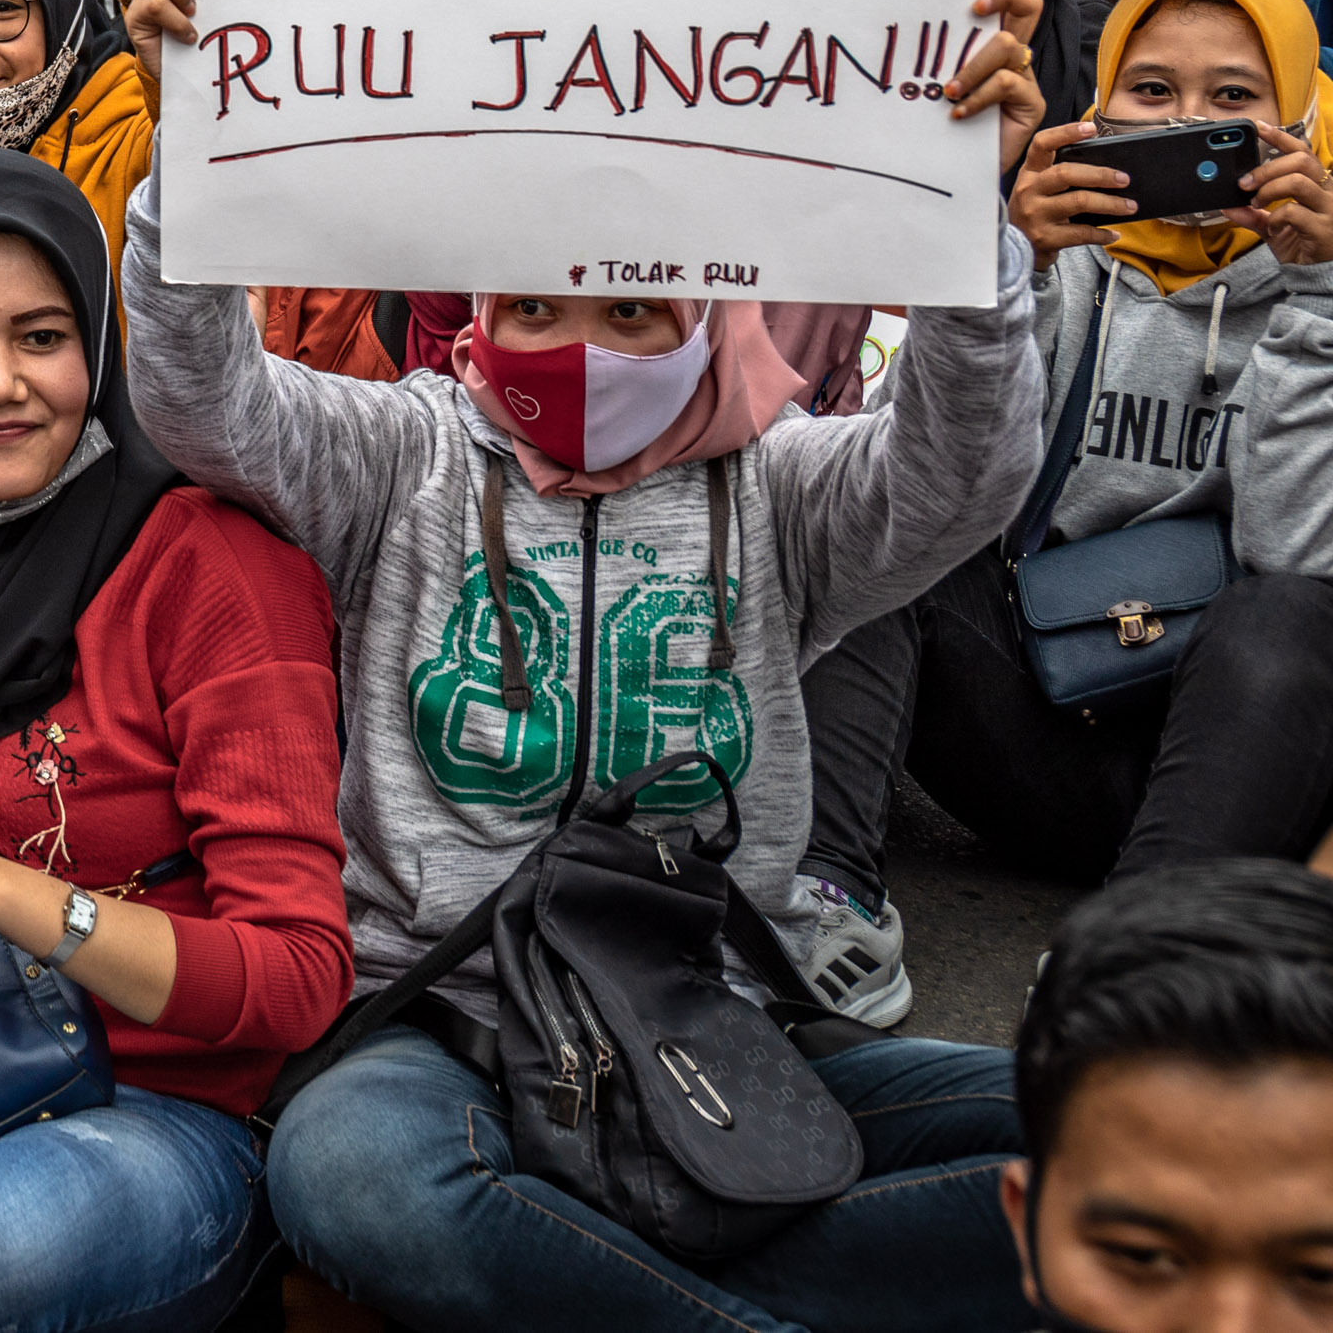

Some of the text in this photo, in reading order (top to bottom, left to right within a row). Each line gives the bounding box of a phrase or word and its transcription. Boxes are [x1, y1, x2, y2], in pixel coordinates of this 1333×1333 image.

[199, 21, 415, 121] RUU
[598, 261, 686, 284] TOLAK
[704, 262, 759, 287] RUU
